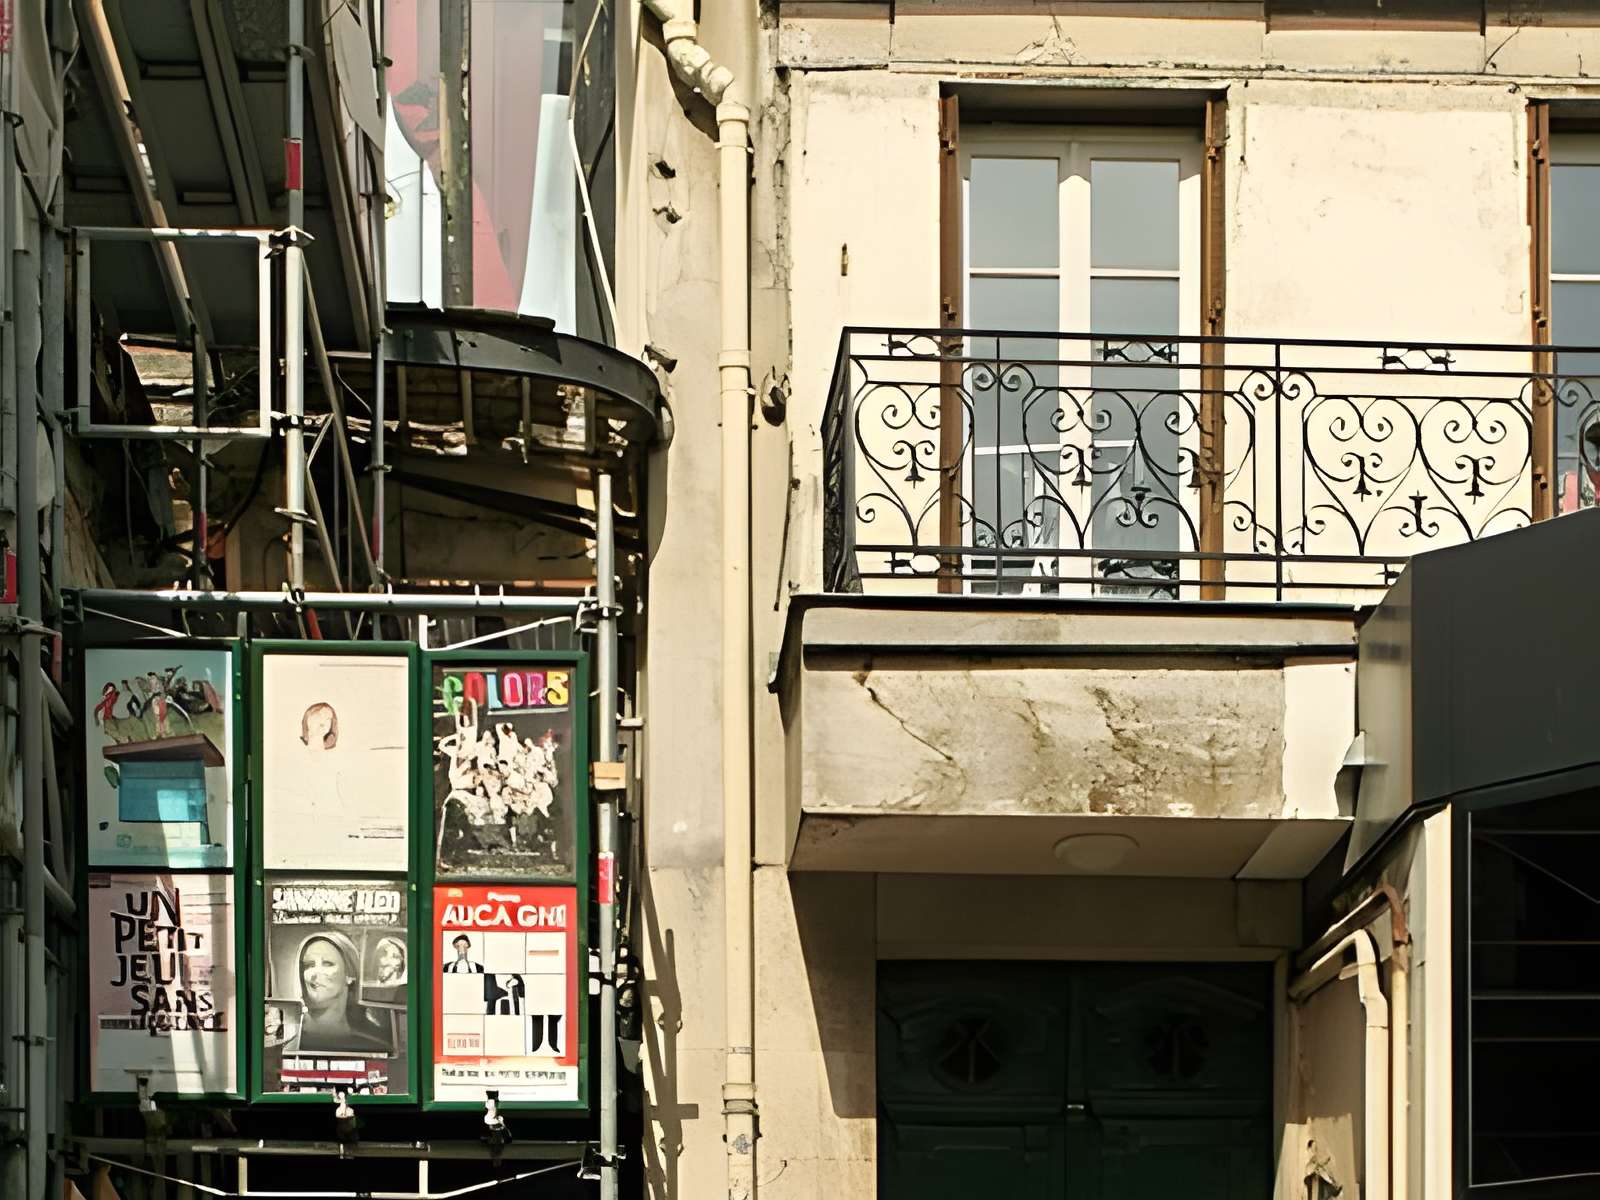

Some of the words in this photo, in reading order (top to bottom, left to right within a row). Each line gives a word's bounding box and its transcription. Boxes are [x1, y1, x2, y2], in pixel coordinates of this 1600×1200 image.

[443, 671, 569, 710] COLORS
[126, 887, 182, 928] UN
[110, 911, 204, 954] PETIT
[131, 984, 214, 1016] SANS
